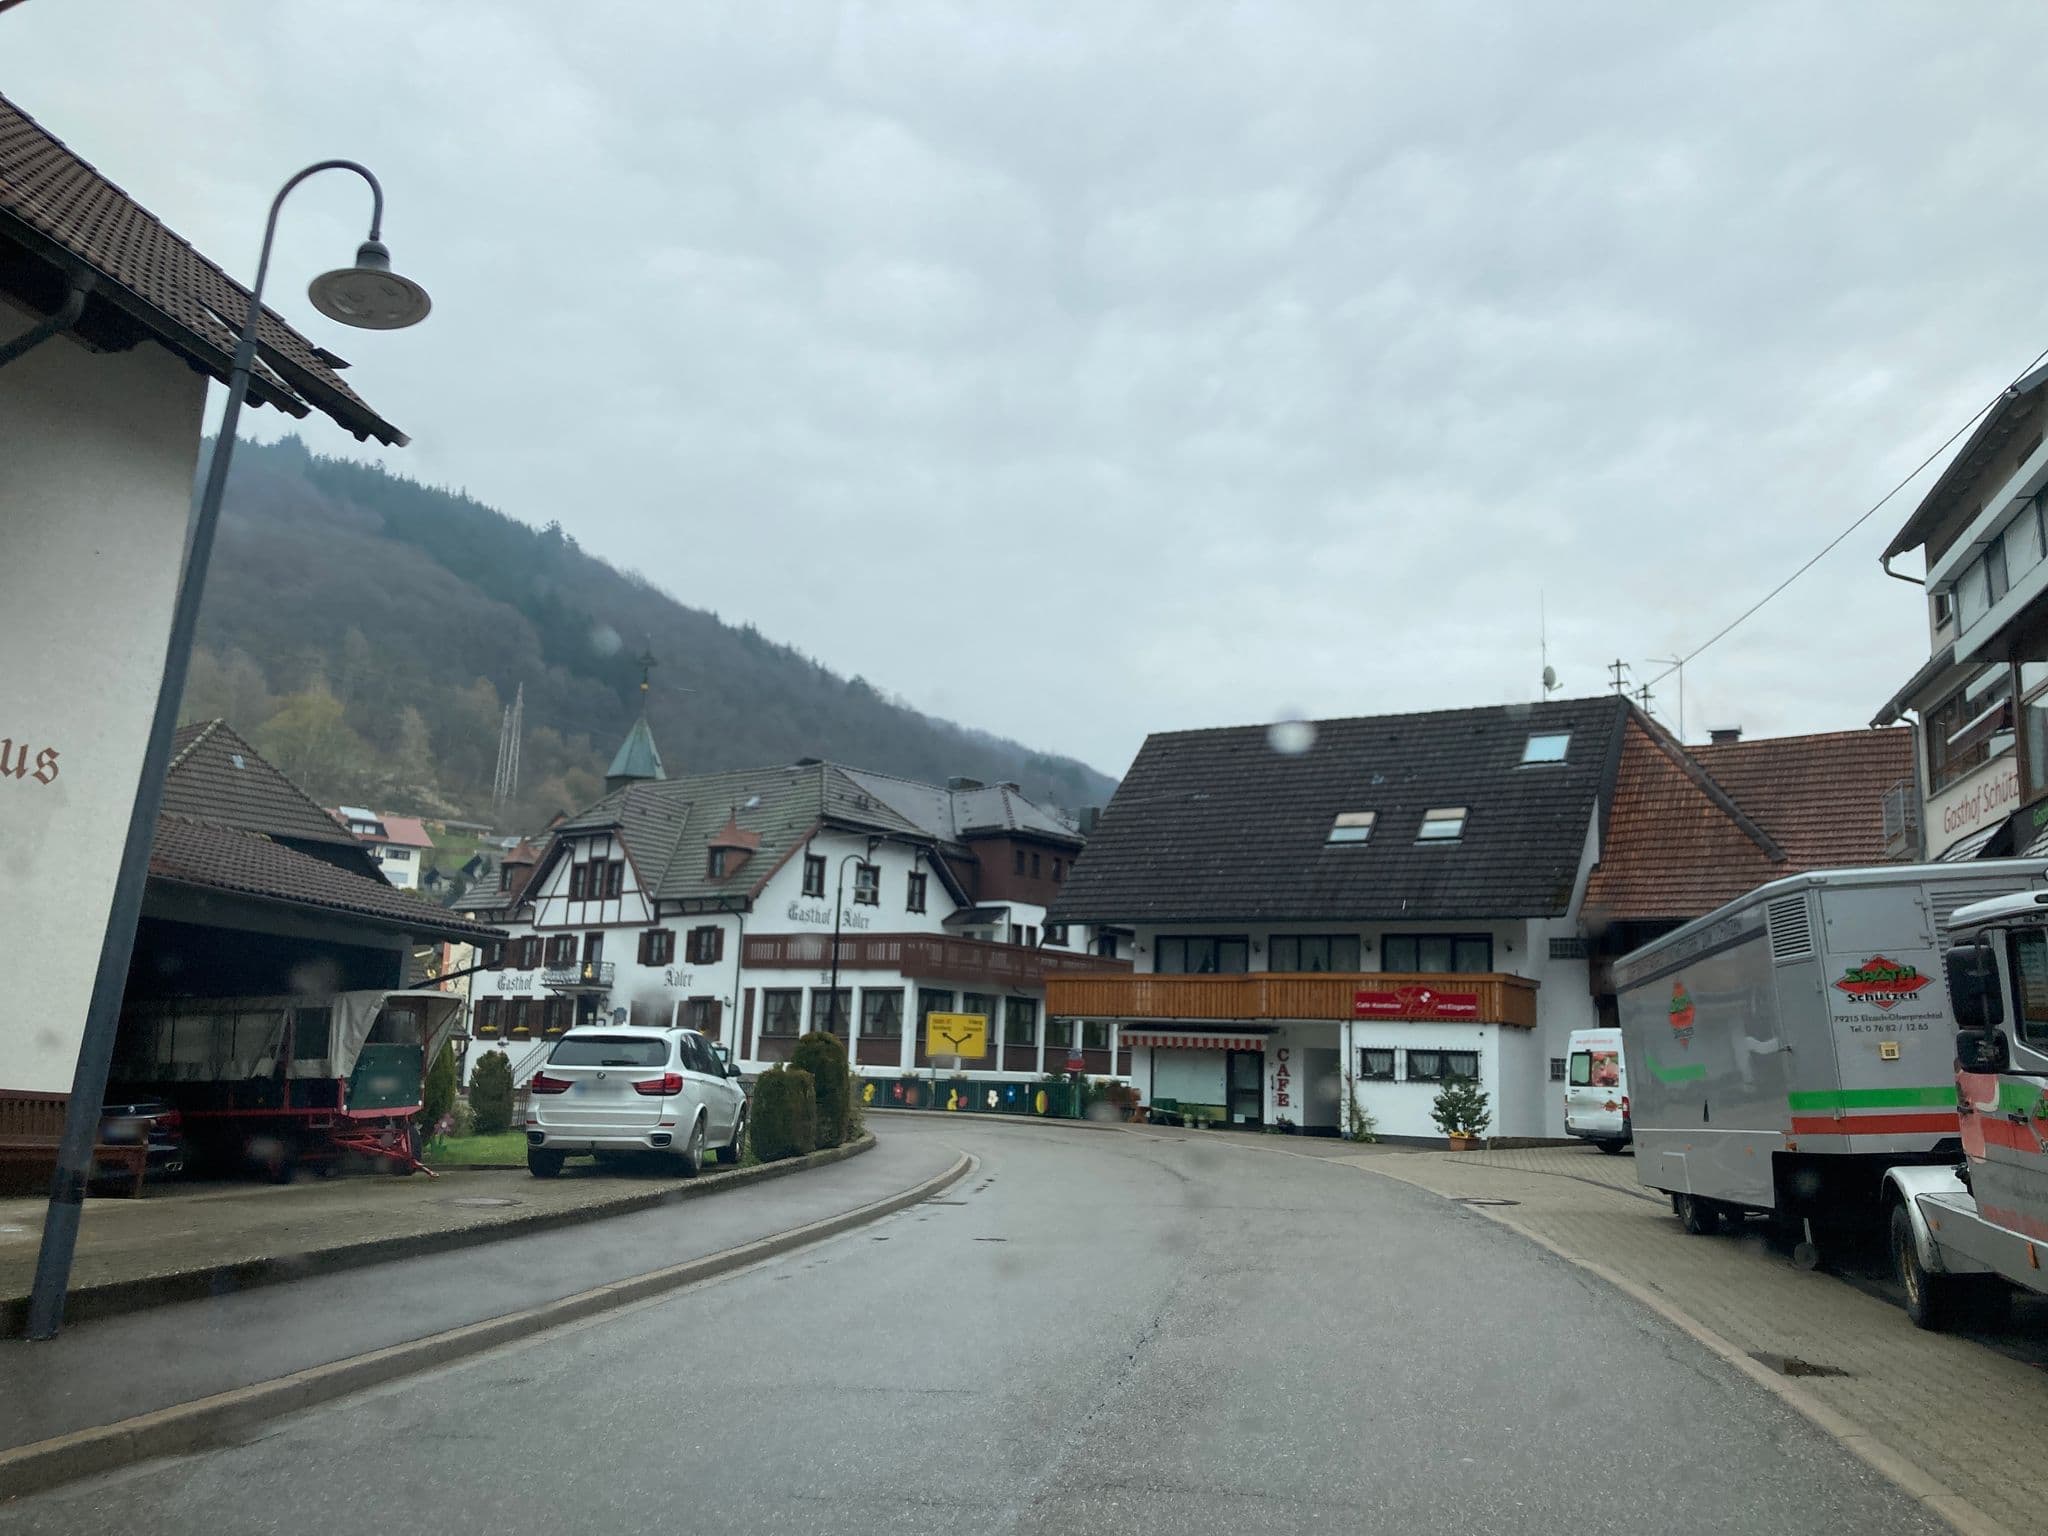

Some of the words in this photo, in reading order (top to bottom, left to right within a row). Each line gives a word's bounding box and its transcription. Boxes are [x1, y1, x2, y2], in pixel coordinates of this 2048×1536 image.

[0, 738, 60, 785] us
[1944, 786, 1982, 834] Gasthof
[787, 903, 832, 925] Gasthof
[842, 907, 870, 929] Adler
[497, 974, 533, 992] Gasthof
[664, 968, 694, 988] Adler
[1847, 992, 1918, 1003] Schützen
[1276, 1047, 1291, 1107] CAFE
